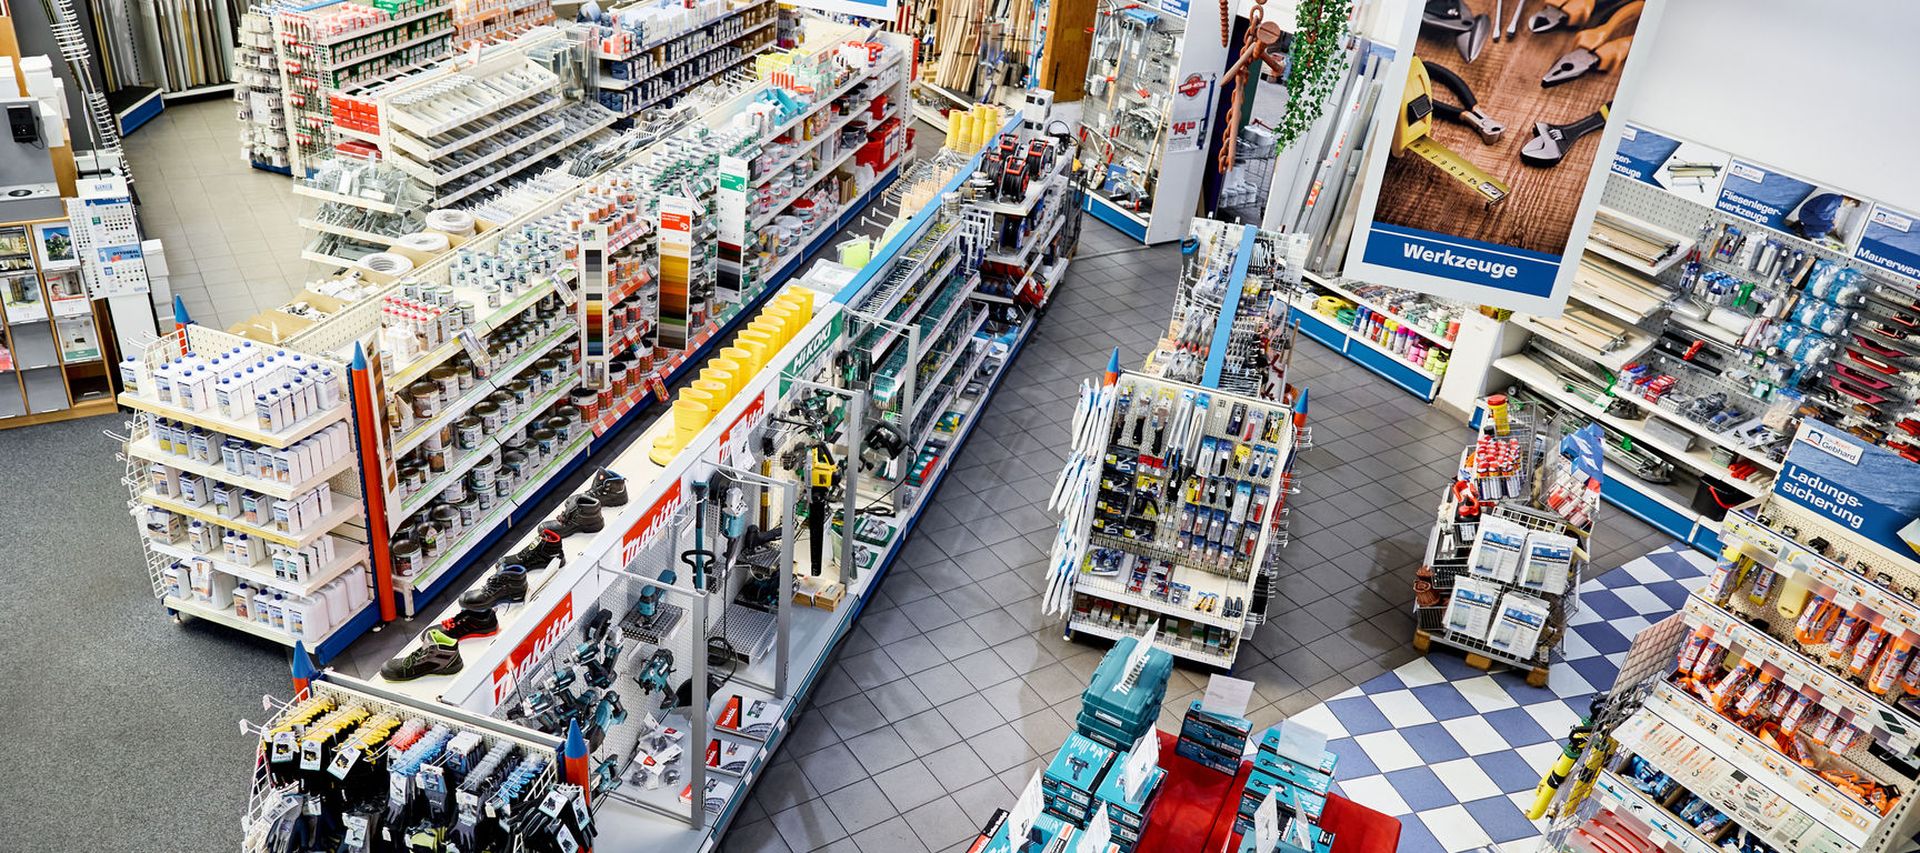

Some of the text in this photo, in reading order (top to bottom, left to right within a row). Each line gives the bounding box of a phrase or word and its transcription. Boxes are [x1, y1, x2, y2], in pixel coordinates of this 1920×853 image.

[1719, 200, 1769, 223] werkzeuge
[1721, 189, 1782, 216] Fliesenleger-
[1403, 242, 1518, 279] Werkzeuge
[792, 321, 832, 374] HiKOKI
[1822, 441, 1857, 462] Gebhard
[1782, 480, 1865, 529] sicherung
[1788, 465, 1863, 507] Ladungs-
